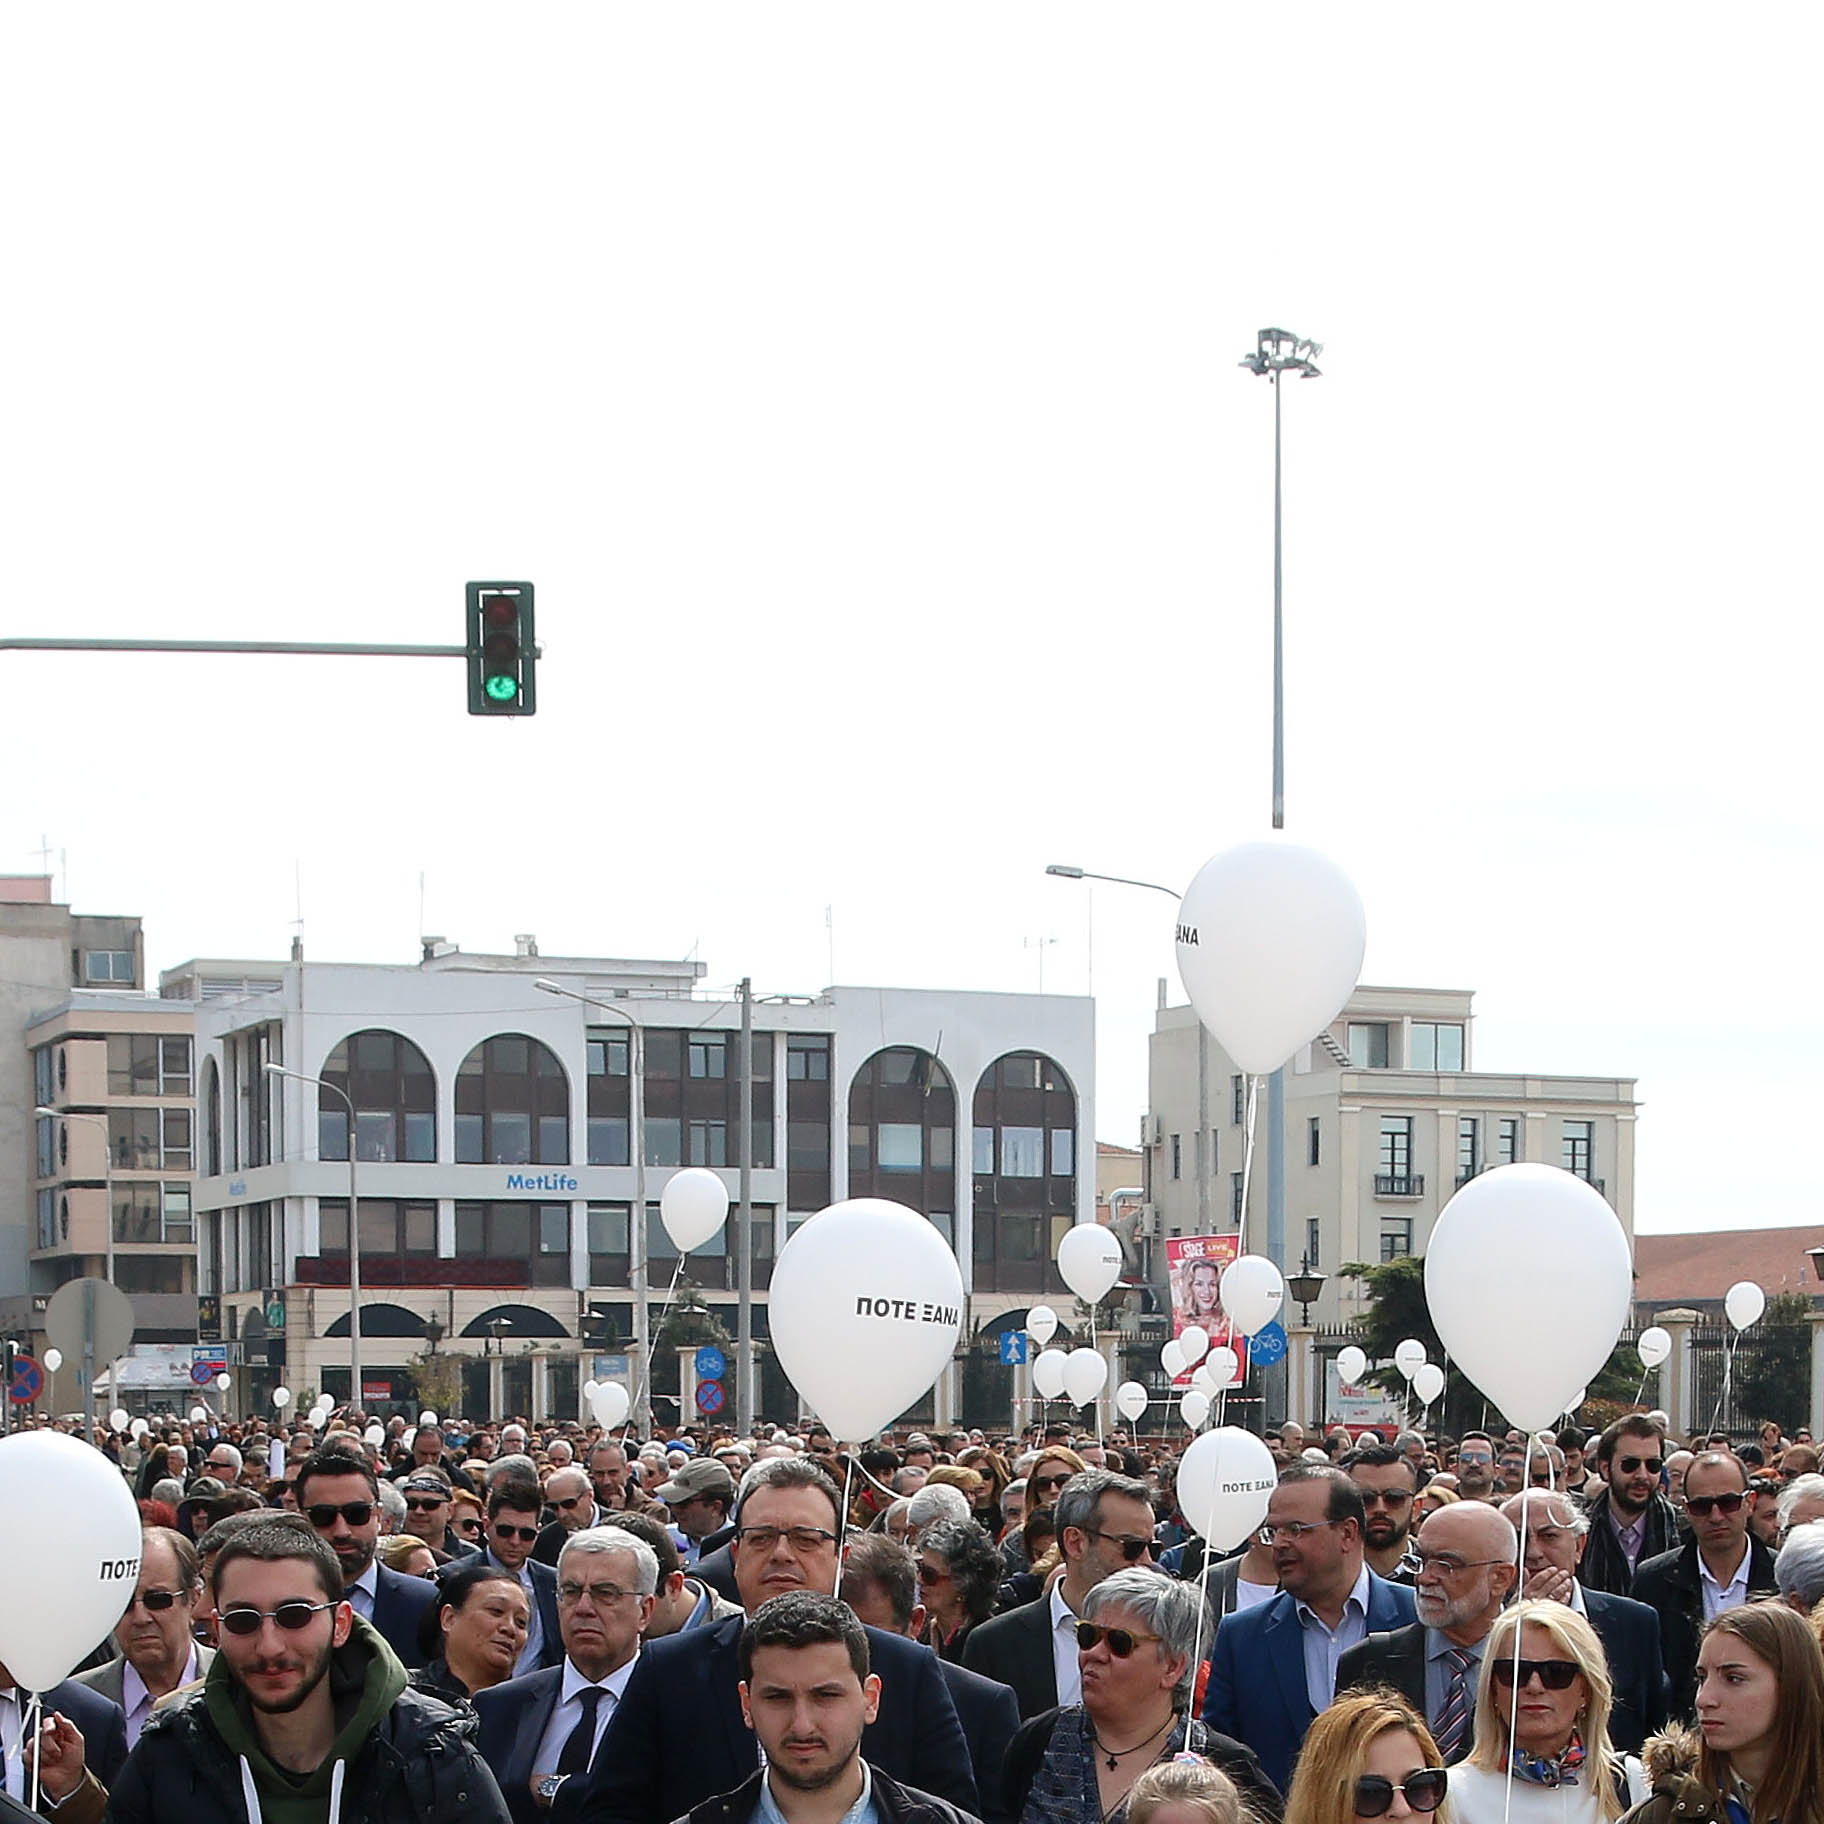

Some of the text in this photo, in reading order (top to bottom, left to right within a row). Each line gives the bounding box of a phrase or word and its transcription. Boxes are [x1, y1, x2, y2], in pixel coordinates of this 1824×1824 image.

[507, 1174, 578, 1191] MetLife
[856, 1297, 917, 1320] ΠΟΤΕ
[1222, 1482, 1253, 1493] ΠΟΤΕ
[100, 1559, 138, 1580] ΠΟΤΕ
